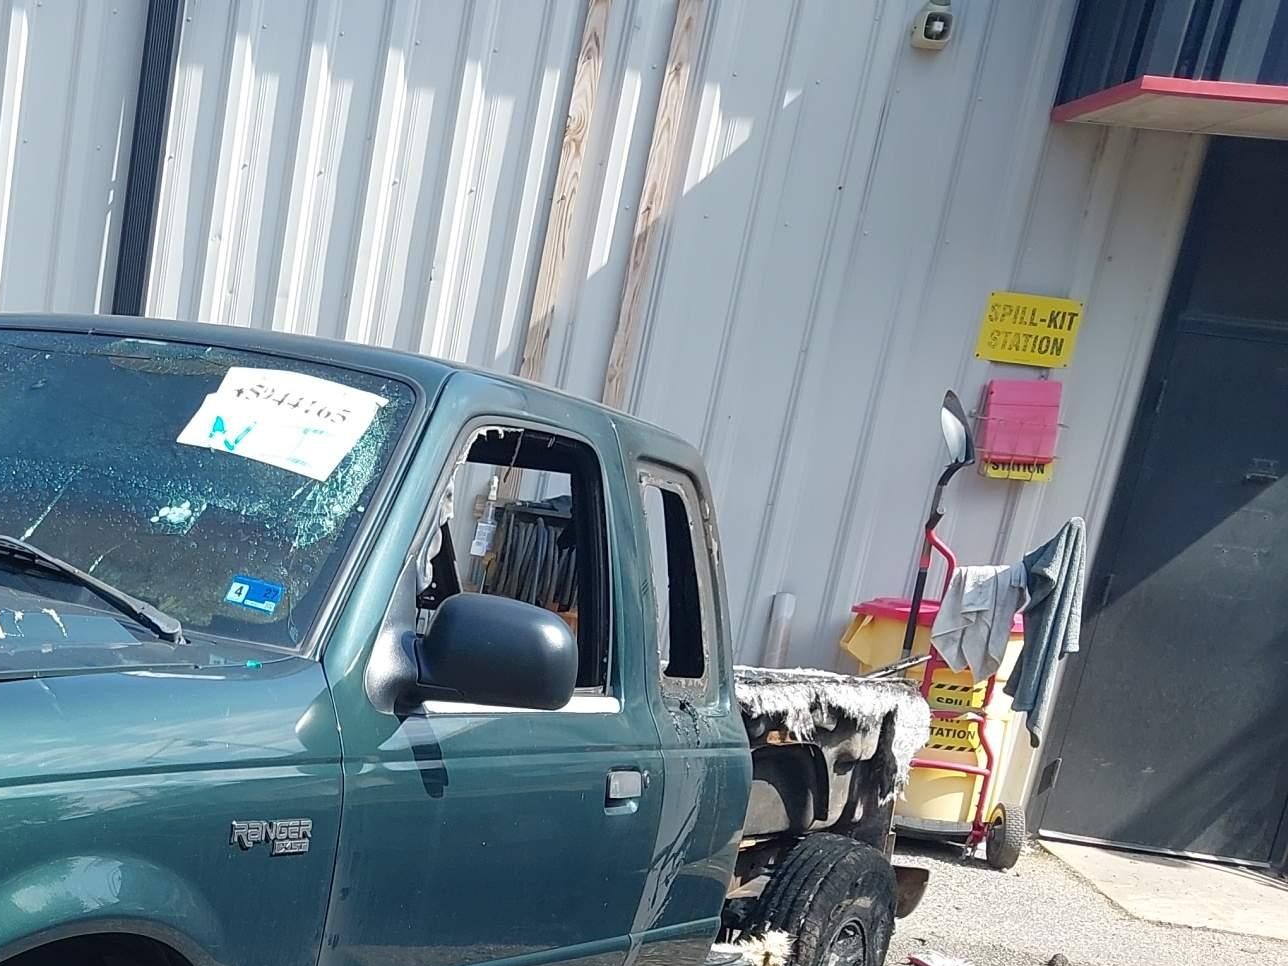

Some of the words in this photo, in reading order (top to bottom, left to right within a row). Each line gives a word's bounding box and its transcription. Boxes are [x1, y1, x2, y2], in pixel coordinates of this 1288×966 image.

[988, 303, 1079, 331] SPILL-KIT
[987, 330, 1065, 357] STATION
[234, 585, 244, 598] 4
[929, 726, 976, 740] TATION
[230, 819, 312, 848] RANGER
